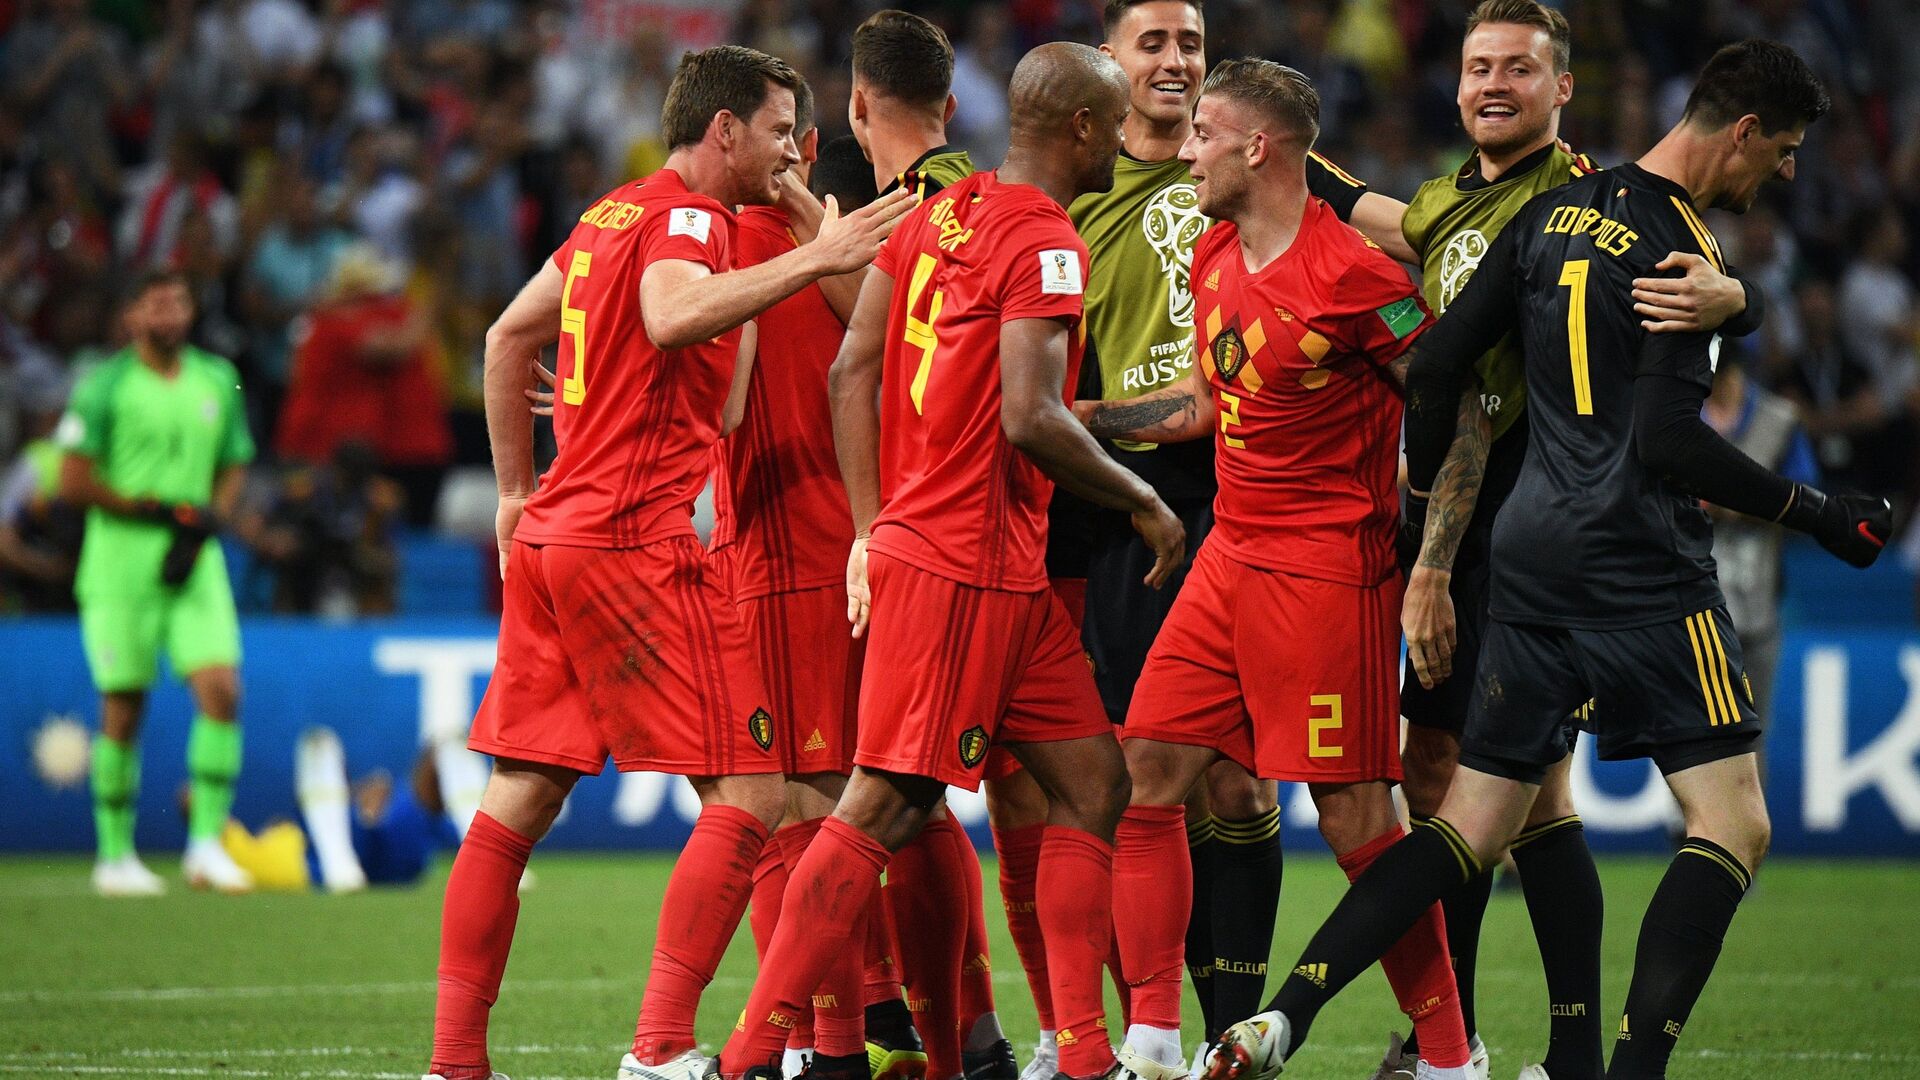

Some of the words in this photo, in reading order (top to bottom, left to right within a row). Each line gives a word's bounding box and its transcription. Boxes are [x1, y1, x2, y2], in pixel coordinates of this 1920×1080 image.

[561, 249, 593, 406] 5
[903, 252, 944, 416] 4
[1150, 342, 1179, 358] FIFA
[1557, 259, 1594, 415] 1
[1220, 390, 1246, 450] 2
[804, 741, 827, 752] adidas
[1308, 694, 1343, 758] 2
[1215, 957, 1267, 976] BELGIUM
[1550, 1003, 1586, 1016] GIUM
